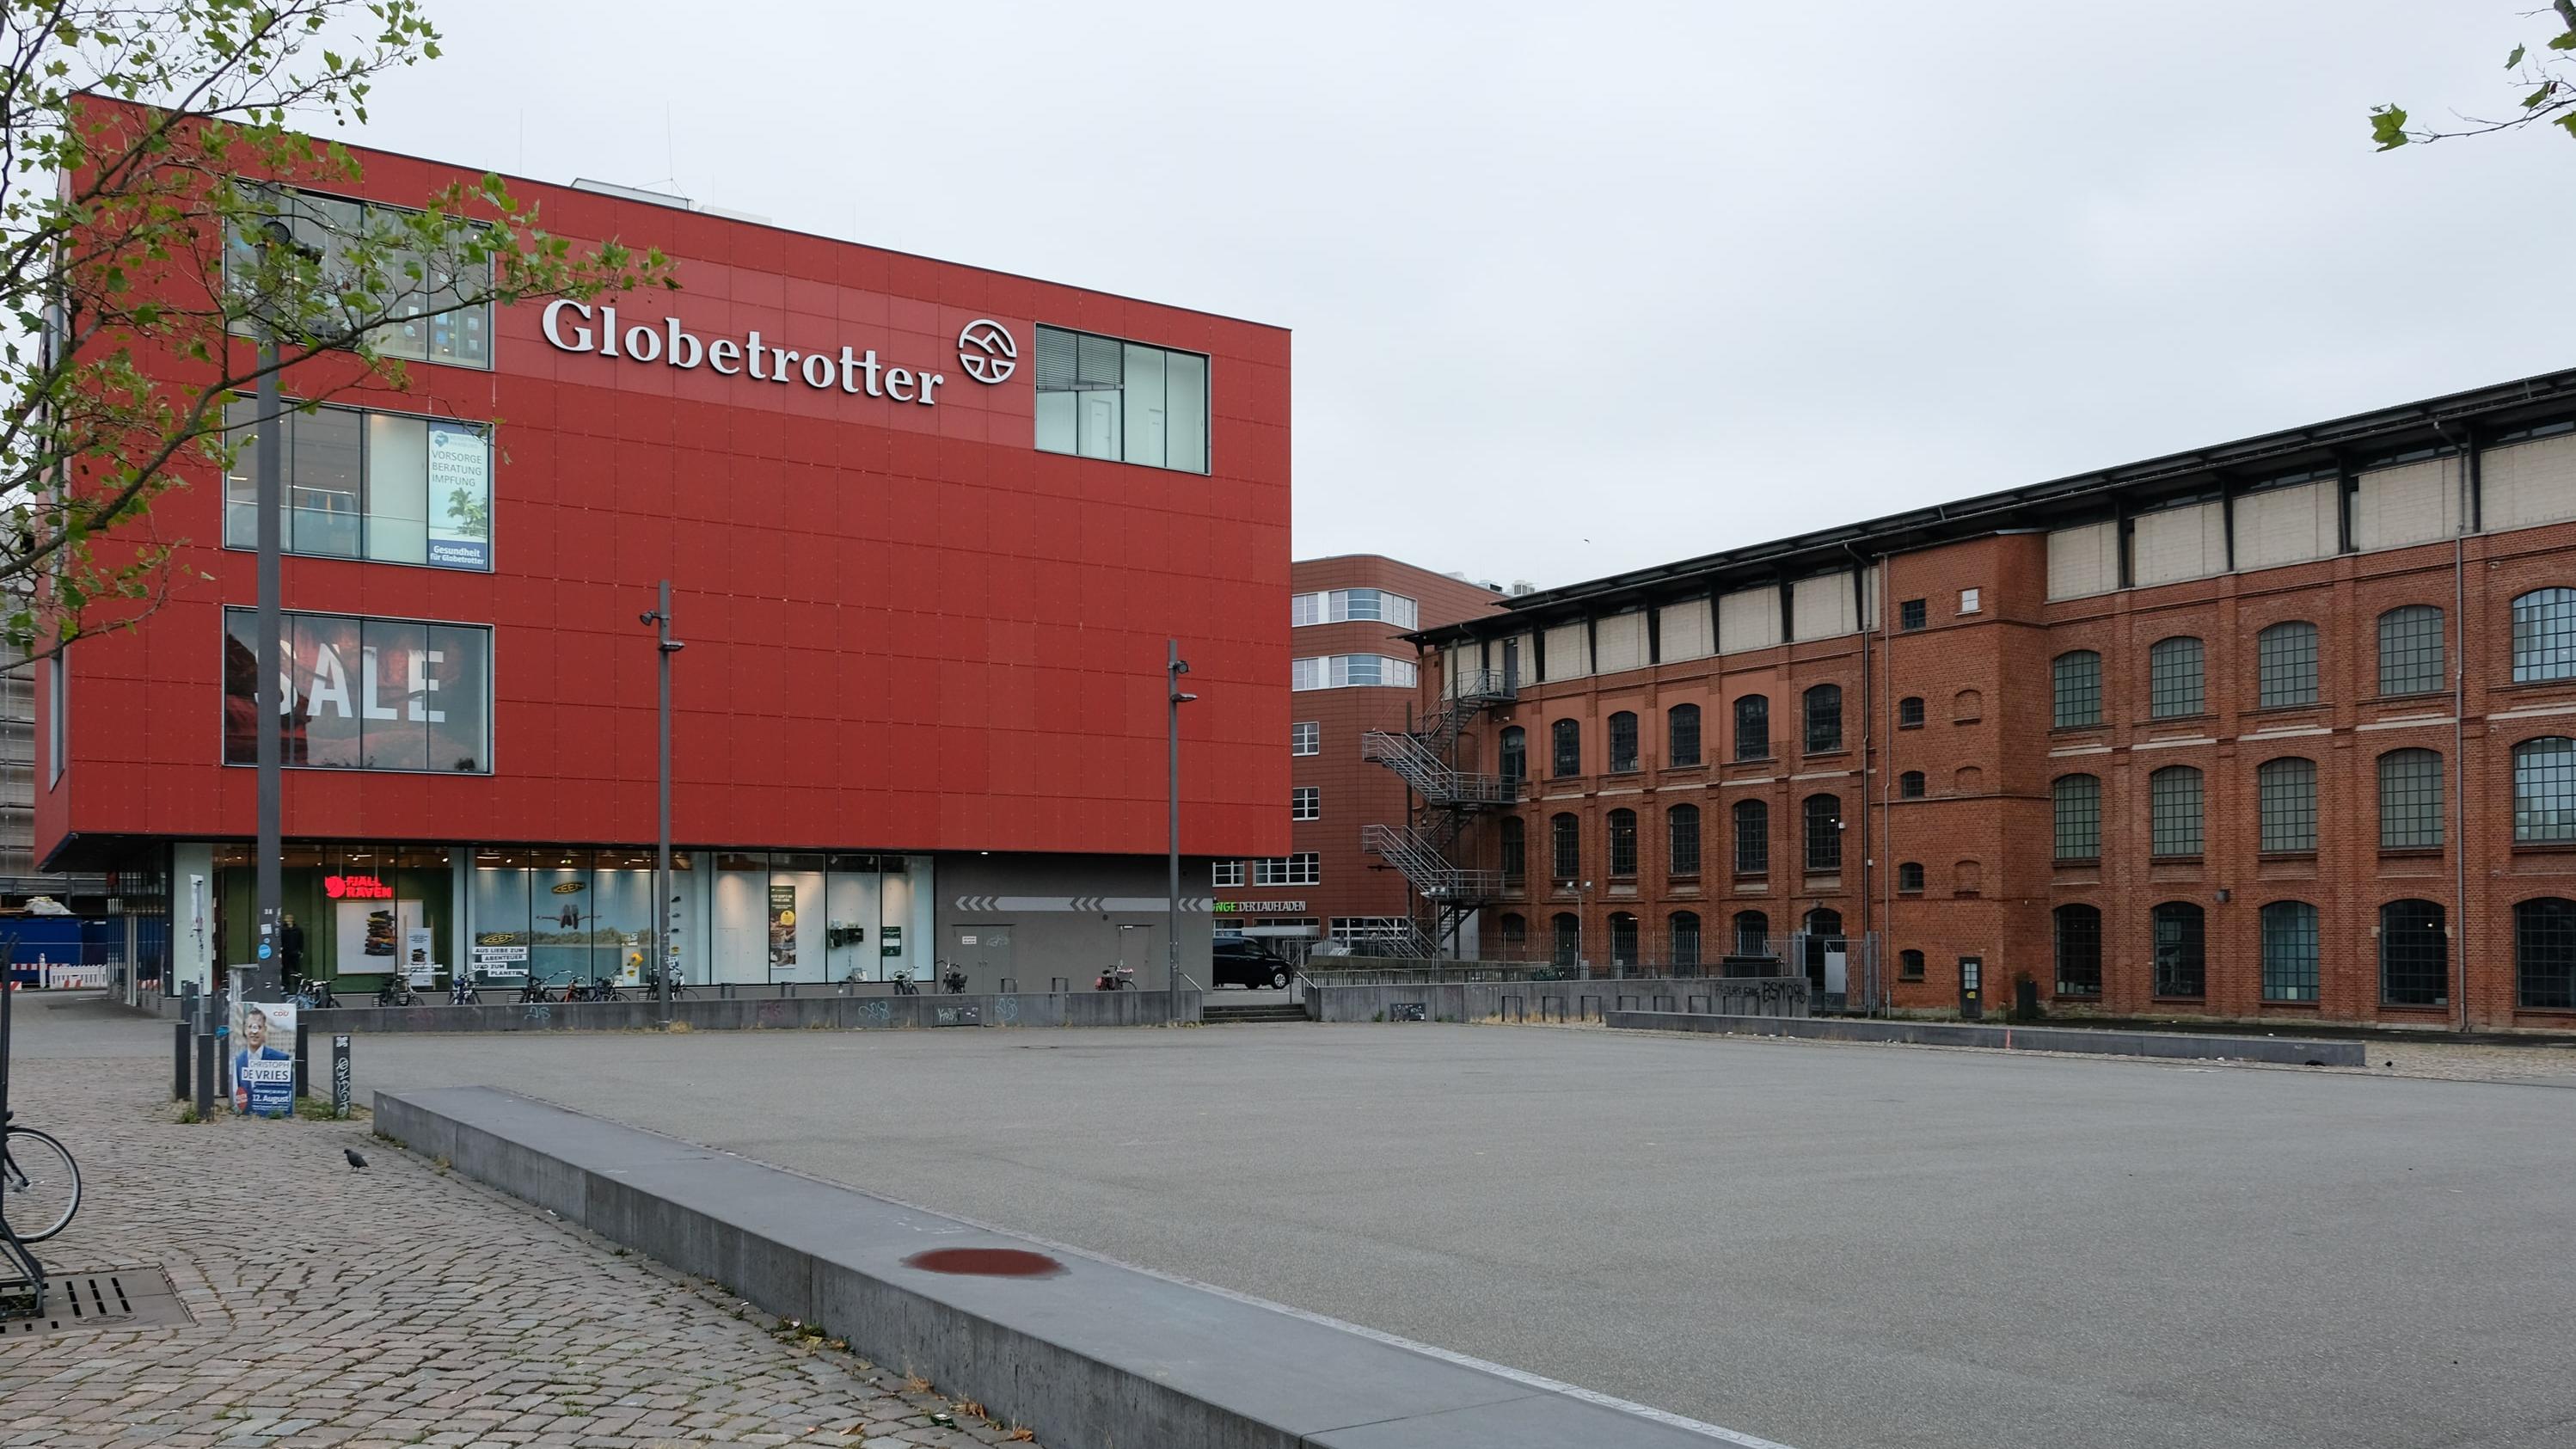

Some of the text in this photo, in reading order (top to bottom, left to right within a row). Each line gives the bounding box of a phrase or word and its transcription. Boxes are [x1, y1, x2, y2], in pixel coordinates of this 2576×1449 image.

[542, 298, 944, 405] Globetrotter
[432, 450, 482, 464] VORSORGE
[432, 462, 482, 476] BERATUNG
[432, 474, 475, 488] IMPFUNG
[433, 545, 481, 557] Gesundheit
[442, 555, 485, 565] Globetrotter
[1239, 901, 1255, 912] DER
[1257, 901, 1306, 912] LAUFLADEN
[243, 1069, 289, 1080] DE VRIES
